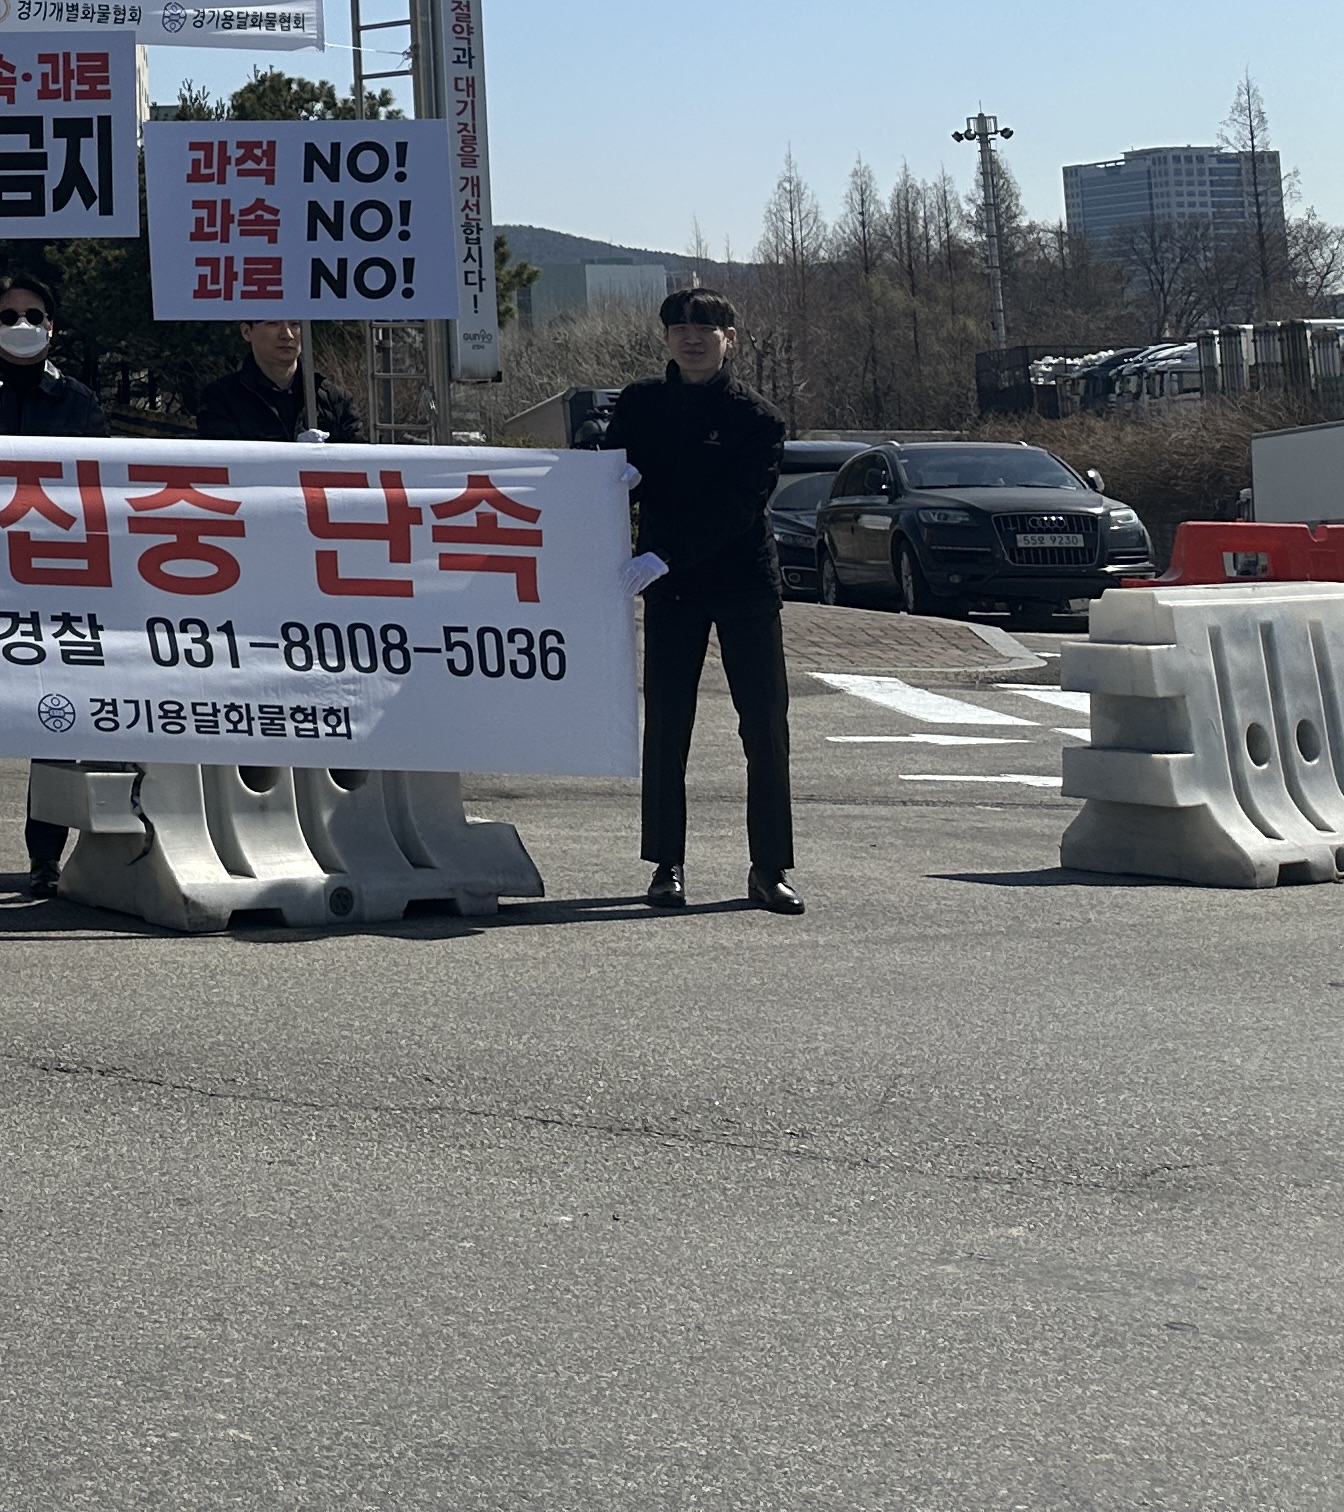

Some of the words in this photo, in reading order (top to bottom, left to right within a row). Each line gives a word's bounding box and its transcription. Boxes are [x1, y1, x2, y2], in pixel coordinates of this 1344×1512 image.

[16, 0, 143, 26] 경기개별화물협회
[191, 7, 306, 33] 경기용달화물협회
[186, 140, 277, 186] 과적
[302, 140, 409, 184] NO!
[189, 197, 281, 244] 과속
[306, 199, 412, 242] NO!
[192, 255, 284, 301] 과로
[310, 256, 416, 300] NO!
[298, 469, 544, 604] 단속
[145, 616, 568, 682] 031-8008-5036
[88, 697, 353, 741] 경기용달화물협회
